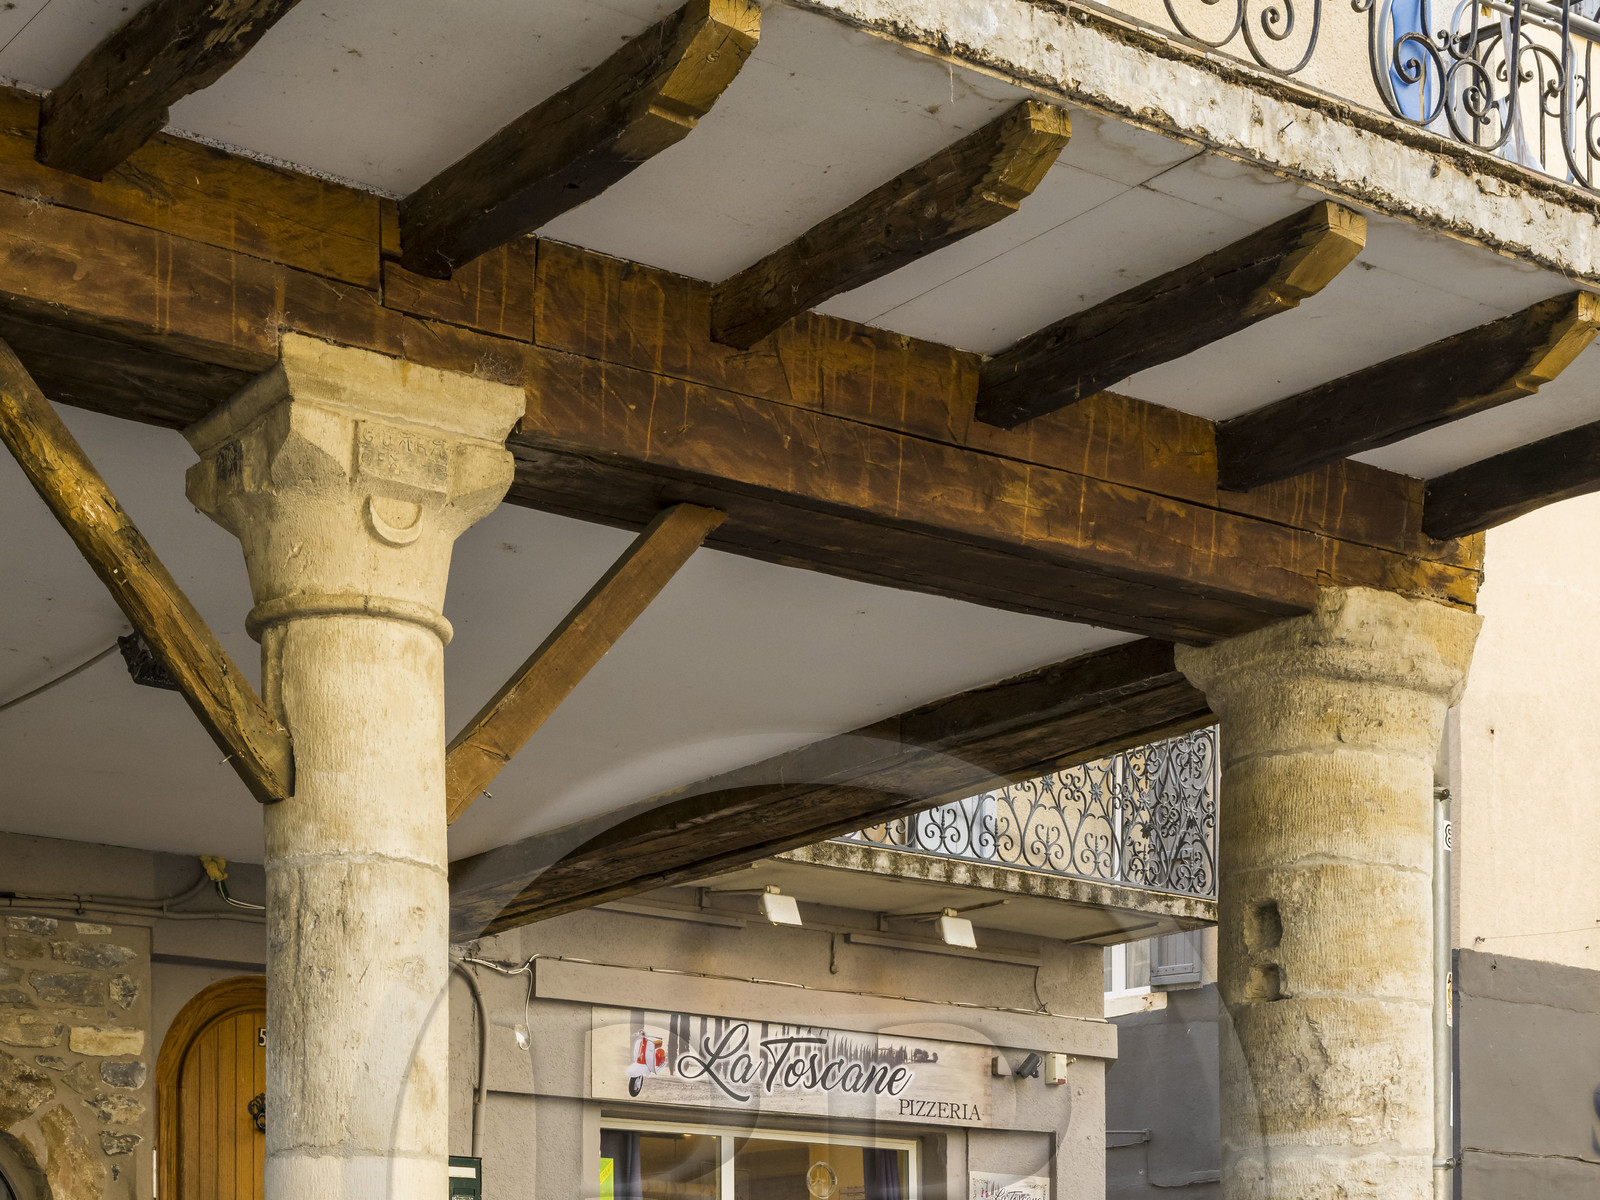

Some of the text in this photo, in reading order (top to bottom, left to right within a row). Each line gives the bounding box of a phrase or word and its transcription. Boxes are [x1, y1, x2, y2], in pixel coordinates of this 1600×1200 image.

[677, 1023, 912, 1101] La Toscane
[899, 1099, 982, 1121] PIZZERIA
